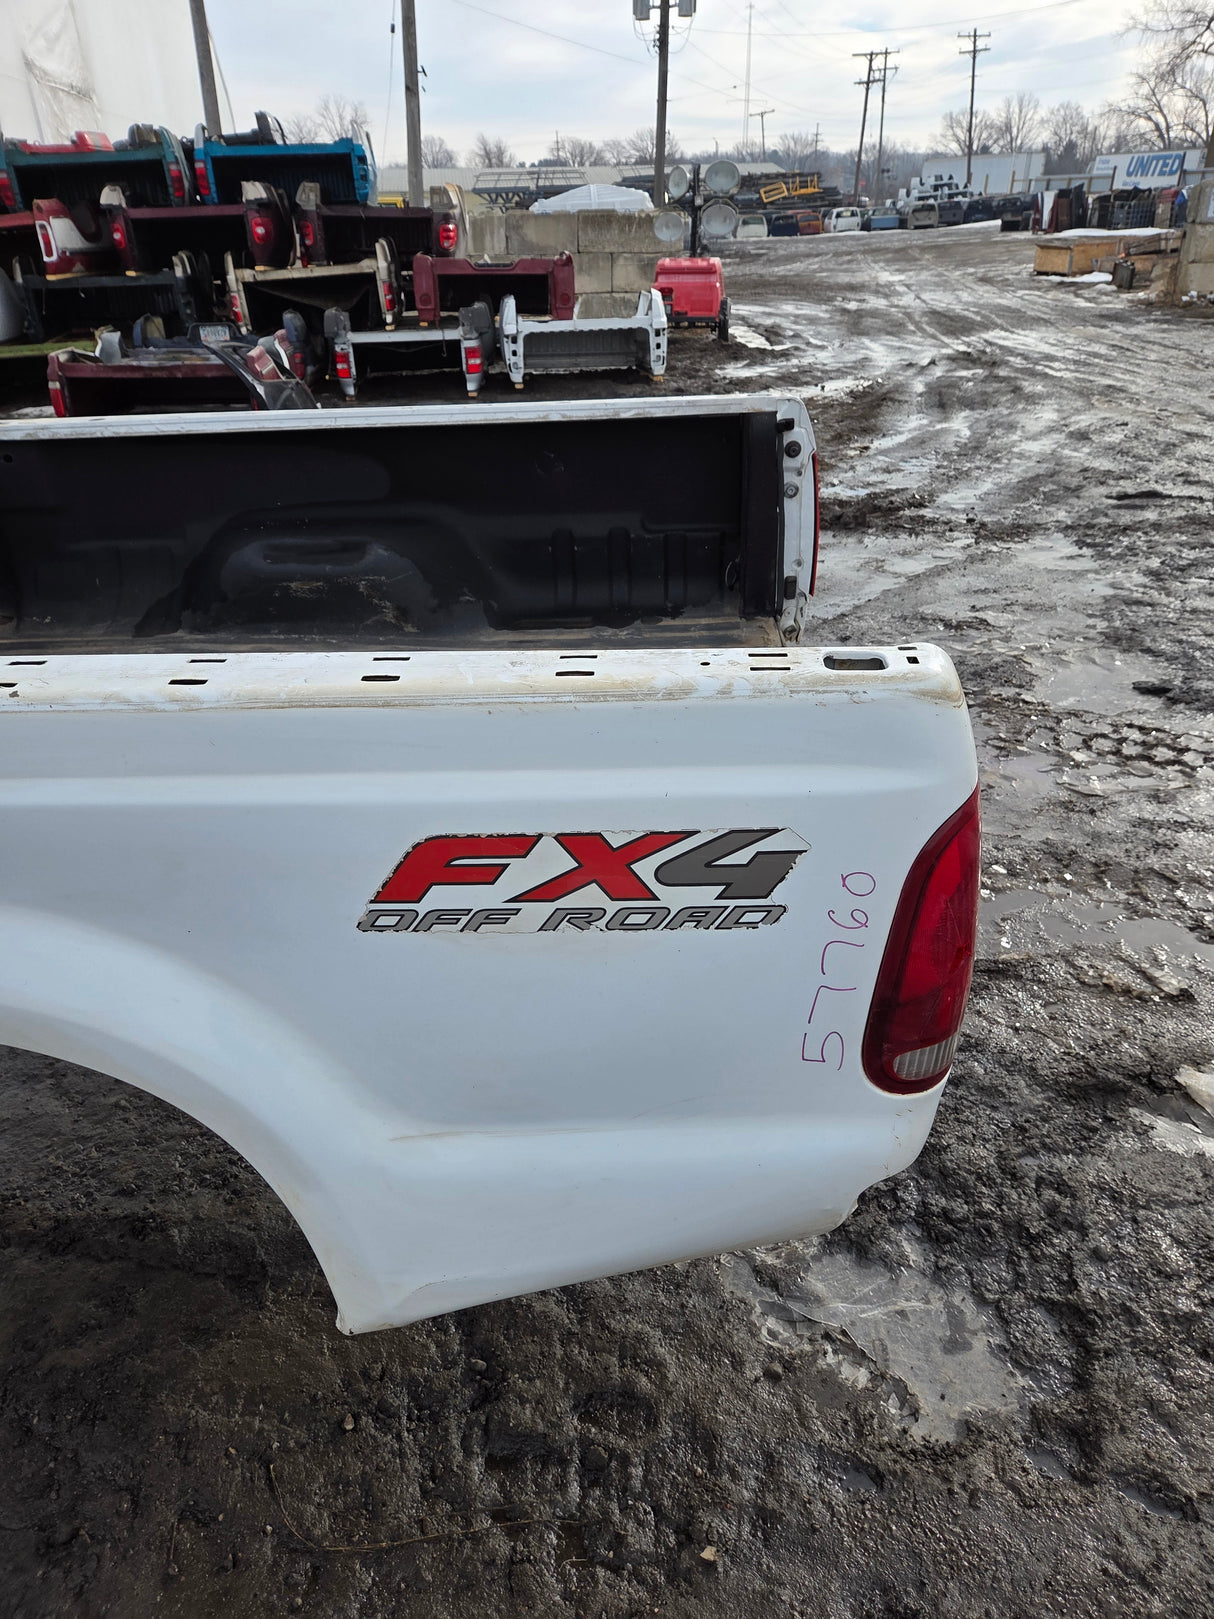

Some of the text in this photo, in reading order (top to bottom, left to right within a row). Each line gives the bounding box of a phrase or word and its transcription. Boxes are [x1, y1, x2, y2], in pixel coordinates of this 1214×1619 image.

[1126, 152, 1183, 177] UNITED
[369, 828, 809, 904] FX4
[357, 904, 788, 932] OFF ROAD
[801, 871, 876, 1071] 57760
